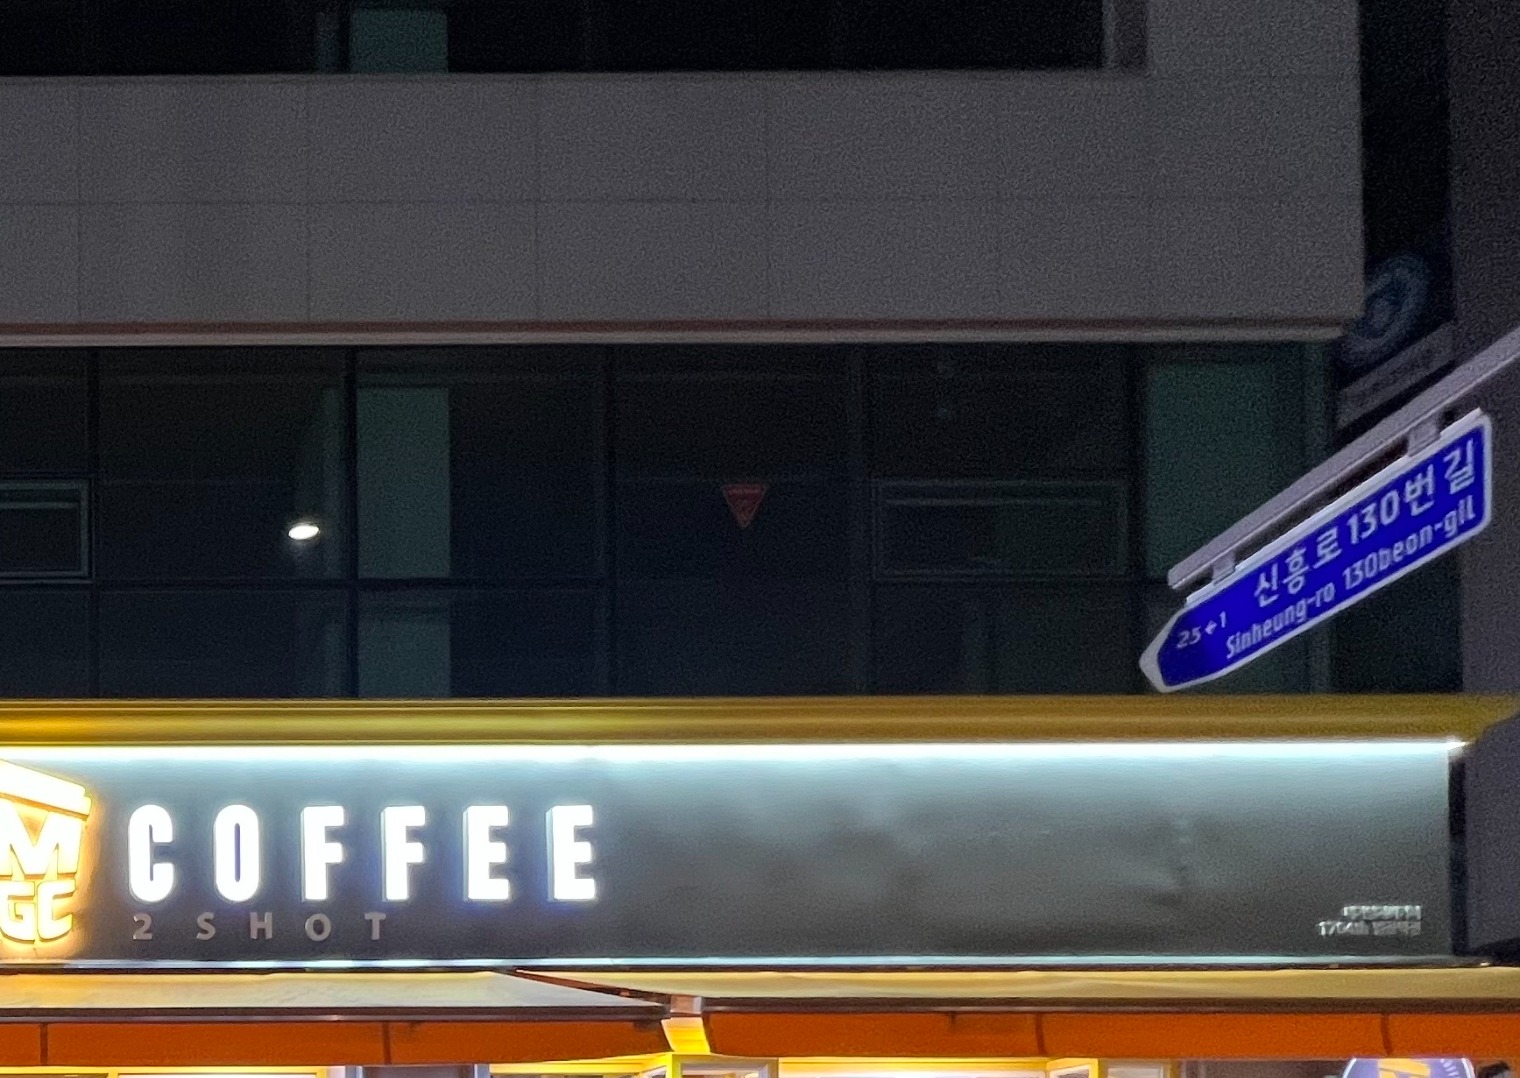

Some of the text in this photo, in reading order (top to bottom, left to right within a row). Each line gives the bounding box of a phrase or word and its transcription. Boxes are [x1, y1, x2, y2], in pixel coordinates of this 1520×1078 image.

[1225, 494, 1476, 660] Sinheung-ro 130beon-gil
[1253, 526, 1343, 608] 신흥로
[127, 803, 598, 902] COFFEE
[131, 912, 153, 941] 2
[195, 911, 387, 942] SHOT
